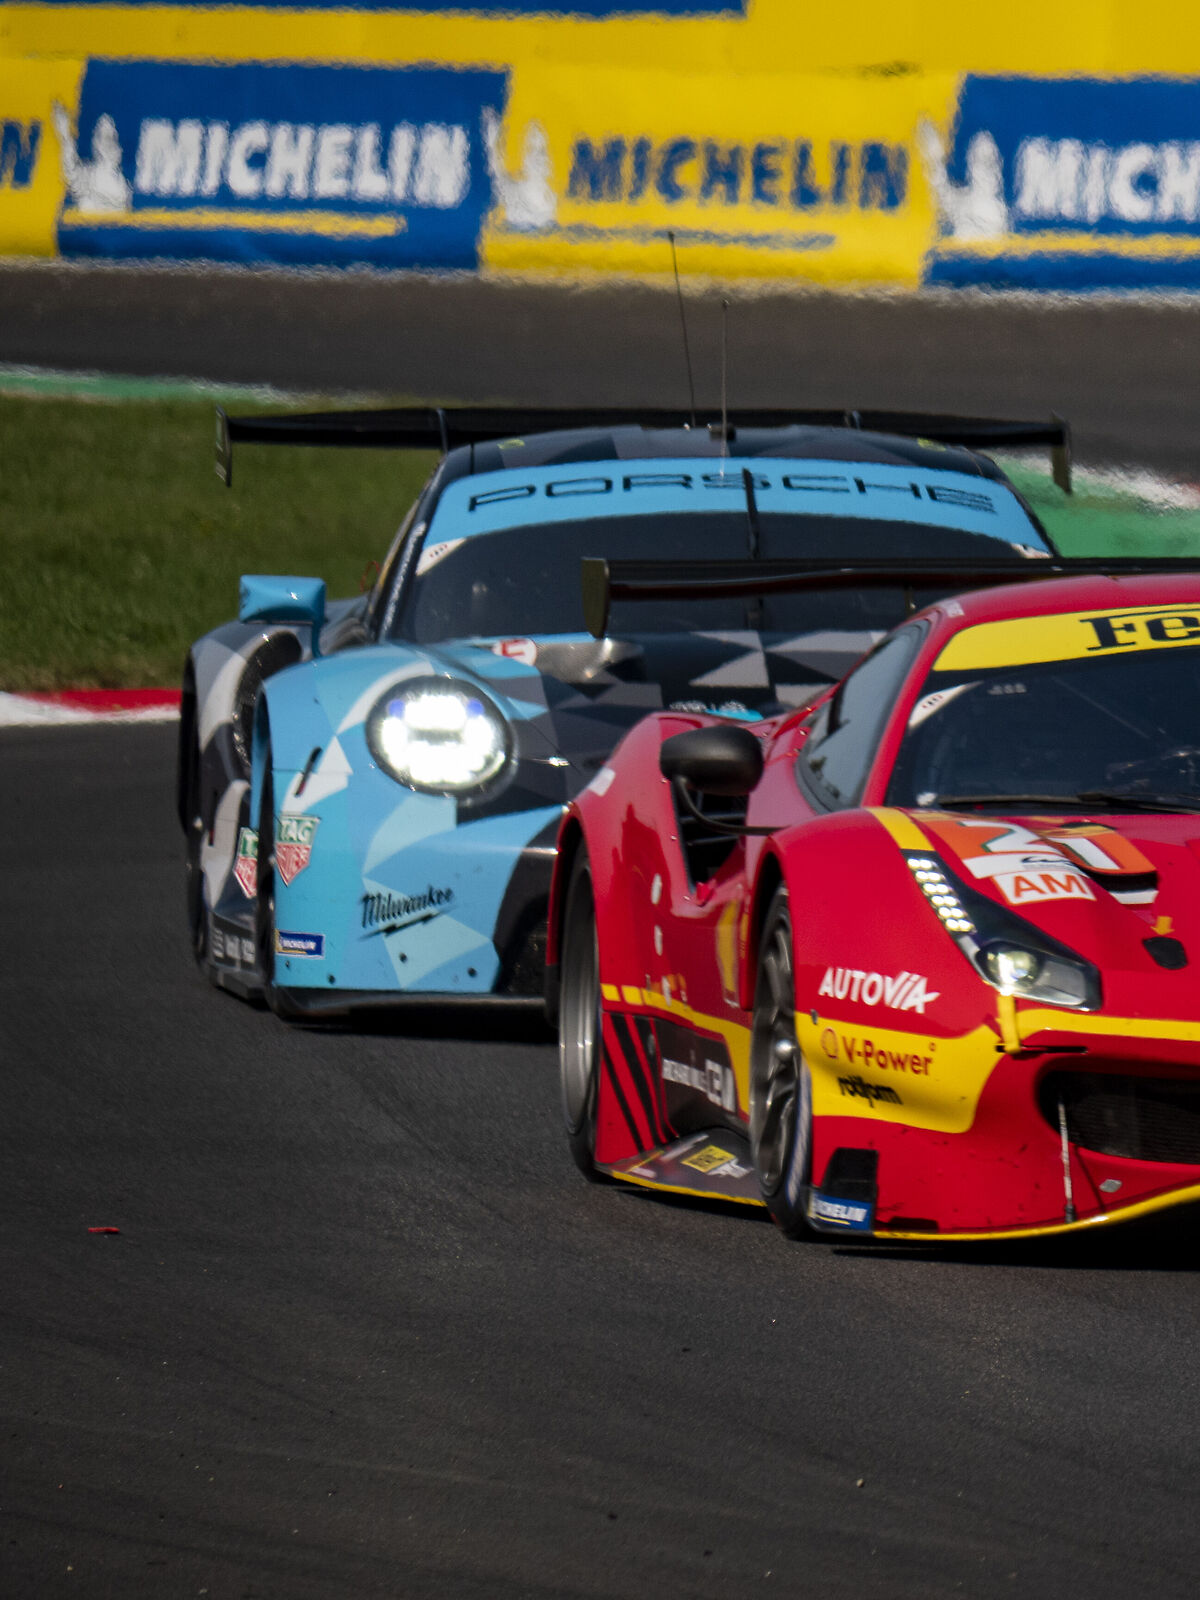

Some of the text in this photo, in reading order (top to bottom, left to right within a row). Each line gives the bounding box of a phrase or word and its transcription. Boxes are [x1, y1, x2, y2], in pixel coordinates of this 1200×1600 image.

[135, 118, 470, 208] MICHELIN
[567, 135, 907, 209] MICHELIN
[468, 472, 997, 513] PORSCHE
[282, 819, 314, 841] TAG
[1013, 873, 1085, 898] AM
[842, 1036, 933, 1076] V-Power
